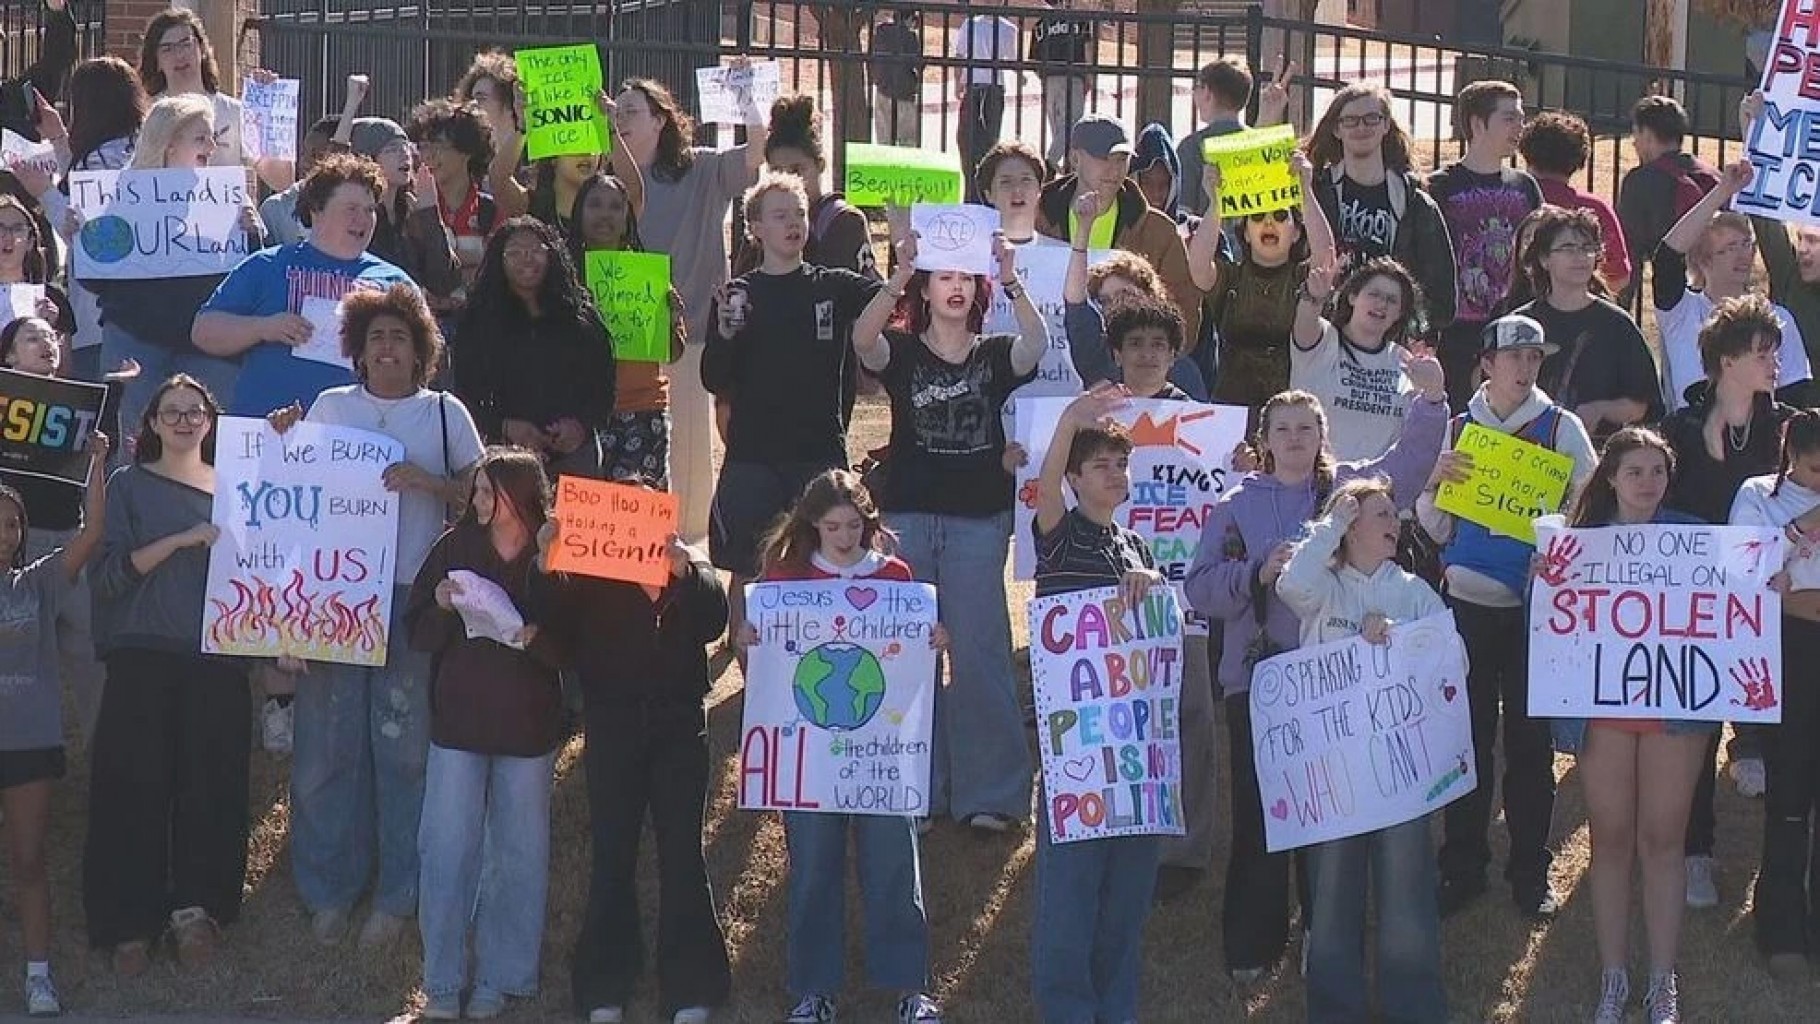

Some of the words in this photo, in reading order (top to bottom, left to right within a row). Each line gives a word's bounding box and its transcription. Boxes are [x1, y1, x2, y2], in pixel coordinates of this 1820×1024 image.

[532, 104, 593, 128] SONIC
[73, 179, 141, 209] This
[153, 176, 217, 204] Land
[224, 184, 242, 204] is
[1736, 151, 1820, 217] IC
[1221, 184, 1300, 215] MATTER
[195, 222, 248, 256] Land
[597, 258, 625, 281] We
[1334, 397, 1391, 416] PRESIDENT
[1350, 388, 1370, 401] BUT
[1373, 392, 1392, 405] THE
[0, 396, 97, 451] SIST
[331, 438, 392, 463] BURN
[1511, 448, 1524, 462] a
[1152, 464, 1226, 493] KINGS
[1477, 465, 1501, 480] to
[236, 480, 323, 531] YOU
[329, 497, 388, 517] BURN
[564, 482, 601, 505] Boo
[1133, 481, 1187, 506] ICE
[628, 527, 637, 538] a
[1612, 531, 1646, 556] NO
[1658, 531, 1711, 557] ONE
[236, 541, 285, 569] with
[1583, 562, 1682, 587] ILLEGAL
[1691, 565, 1727, 587] ON
[758, 585, 833, 609] Jesus
[881, 586, 923, 614] the
[1548, 588, 1763, 640] STOLEN
[849, 615, 931, 641] Children
[1040, 594, 1179, 655] CARING
[1069, 646, 1177, 702] ABOUT
[1284, 643, 1362, 708] SPEAKING
[1593, 642, 1721, 711] LAND
[1047, 697, 1175, 757] PEOPLE
[1266, 717, 1305, 764] FOR
[1311, 700, 1355, 744] THE
[1365, 674, 1424, 732] KIDS
[740, 725, 820, 809] ALL
[839, 761, 860, 780] of
[868, 761, 900, 781] the
[1101, 744, 1144, 785] IS
[833, 785, 922, 811] WORLD
[1283, 749, 1356, 828] WHO
